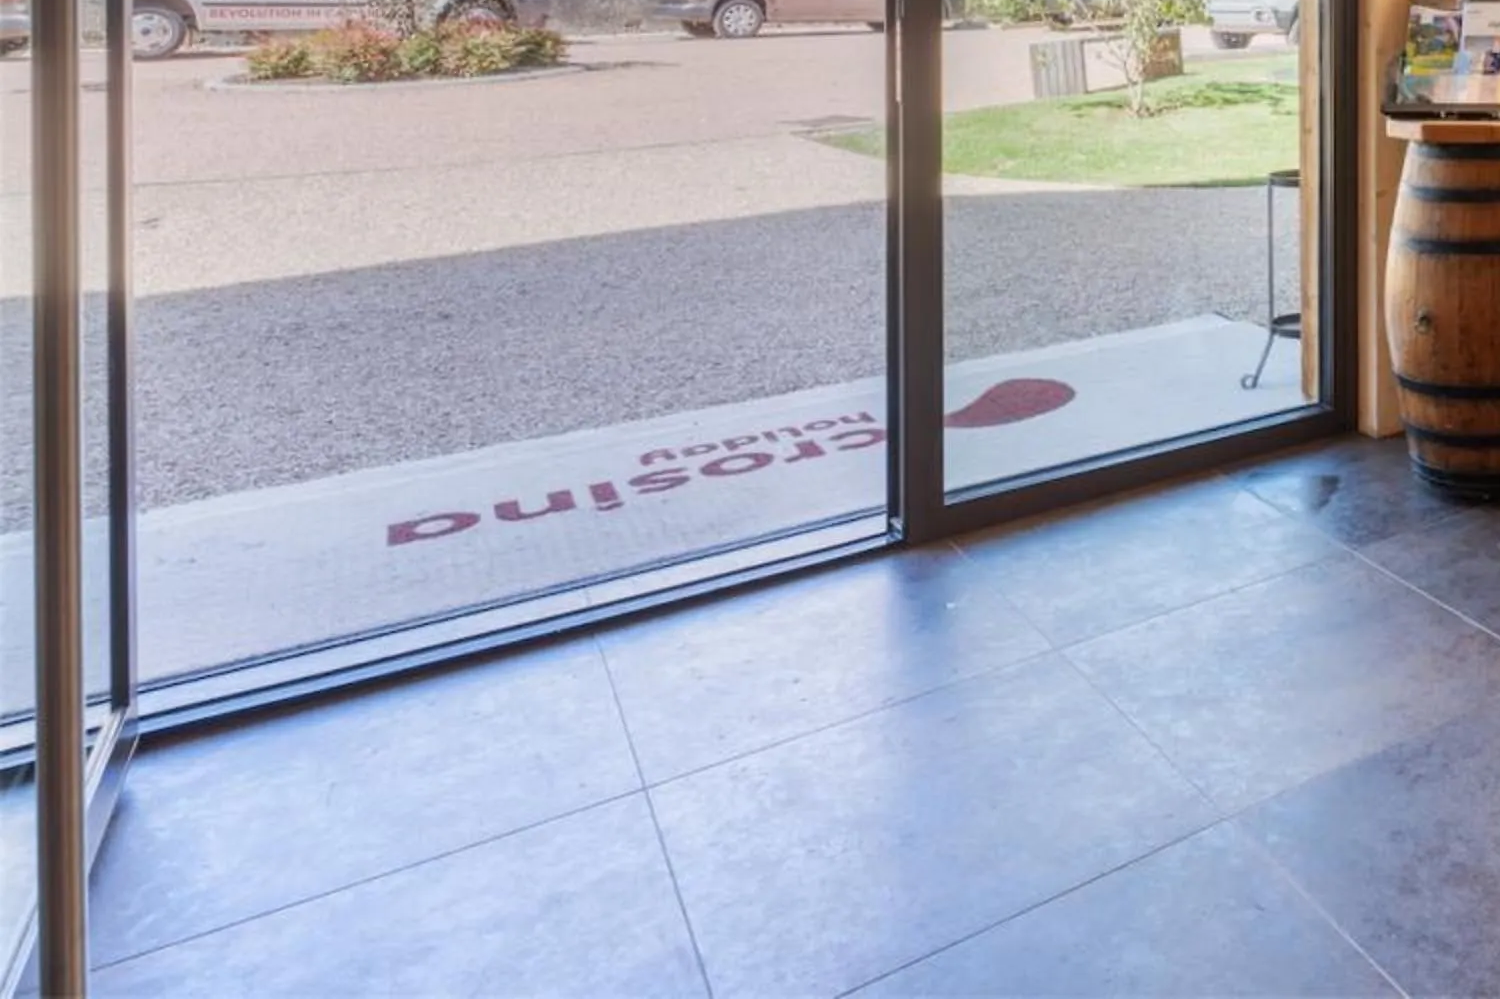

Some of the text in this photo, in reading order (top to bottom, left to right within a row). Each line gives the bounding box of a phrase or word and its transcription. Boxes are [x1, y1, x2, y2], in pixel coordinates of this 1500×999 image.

[209, 7, 300, 20] REVOLUTION
[638, 411, 877, 467] holiday
[387, 427, 887, 546] crosina
